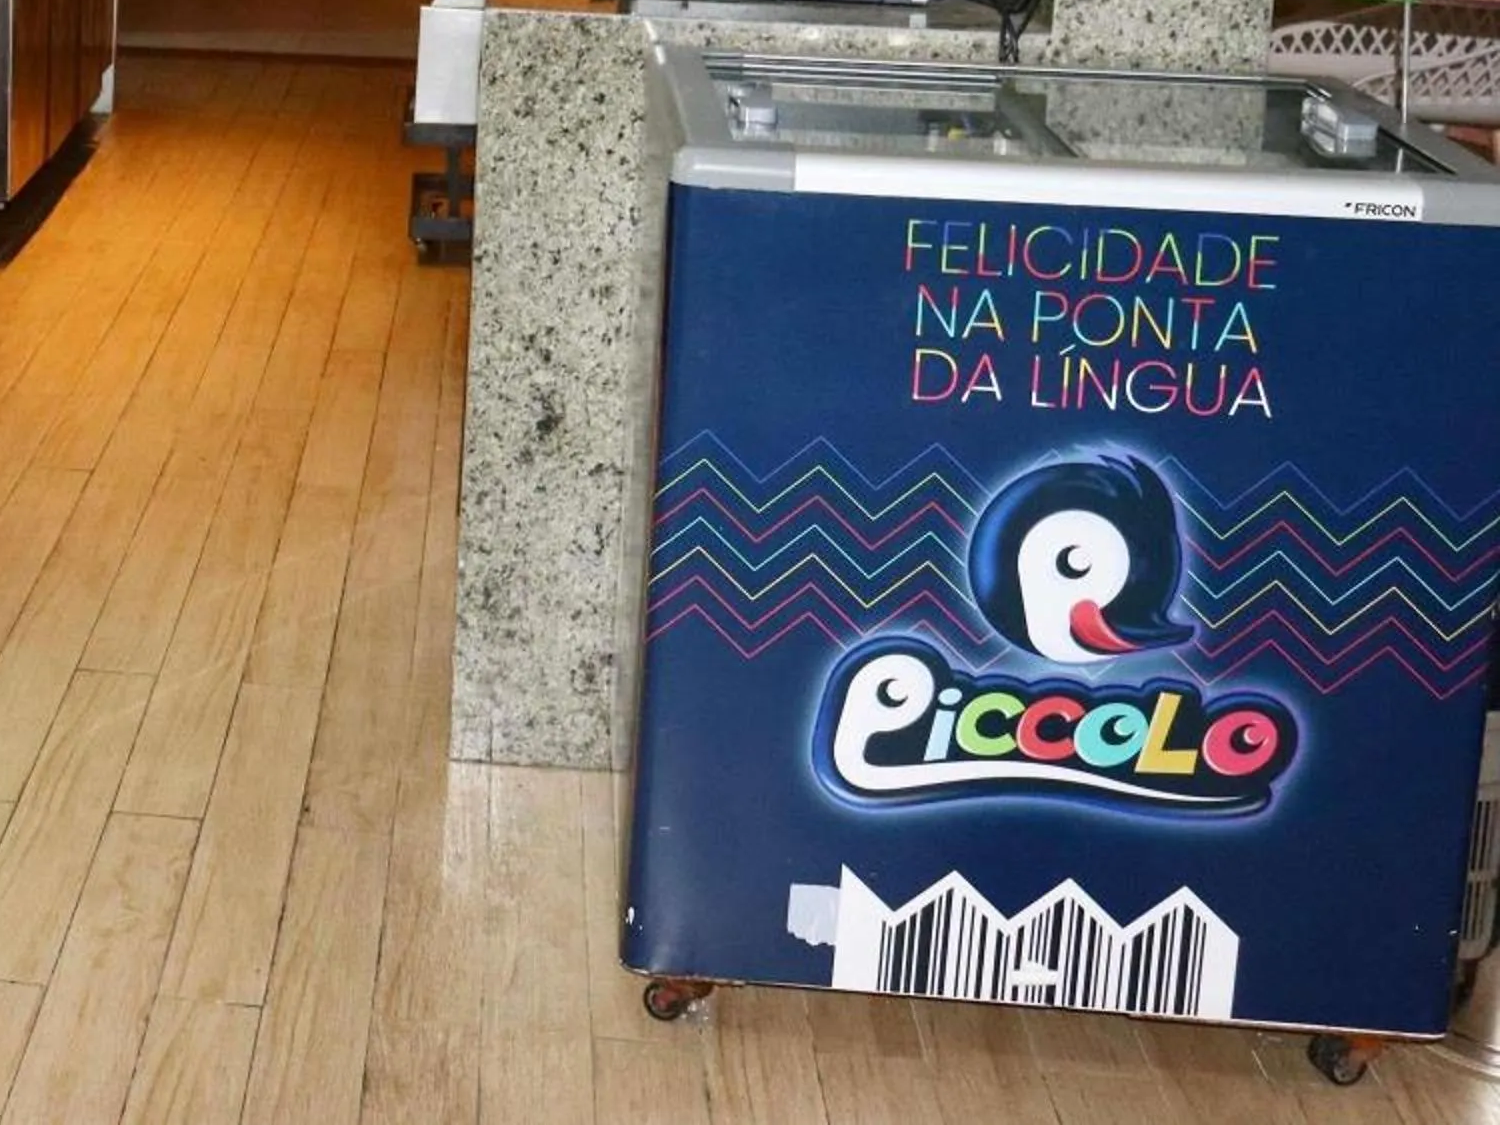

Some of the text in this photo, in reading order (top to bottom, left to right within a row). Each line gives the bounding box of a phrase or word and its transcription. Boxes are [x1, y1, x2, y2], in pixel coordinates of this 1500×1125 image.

[1354, 202, 1417, 217] FRICON
[904, 218, 1280, 290] FELICIDADE
[916, 284, 1258, 354] NA PONTA
[912, 343, 1273, 419] DA LÍNGUA
